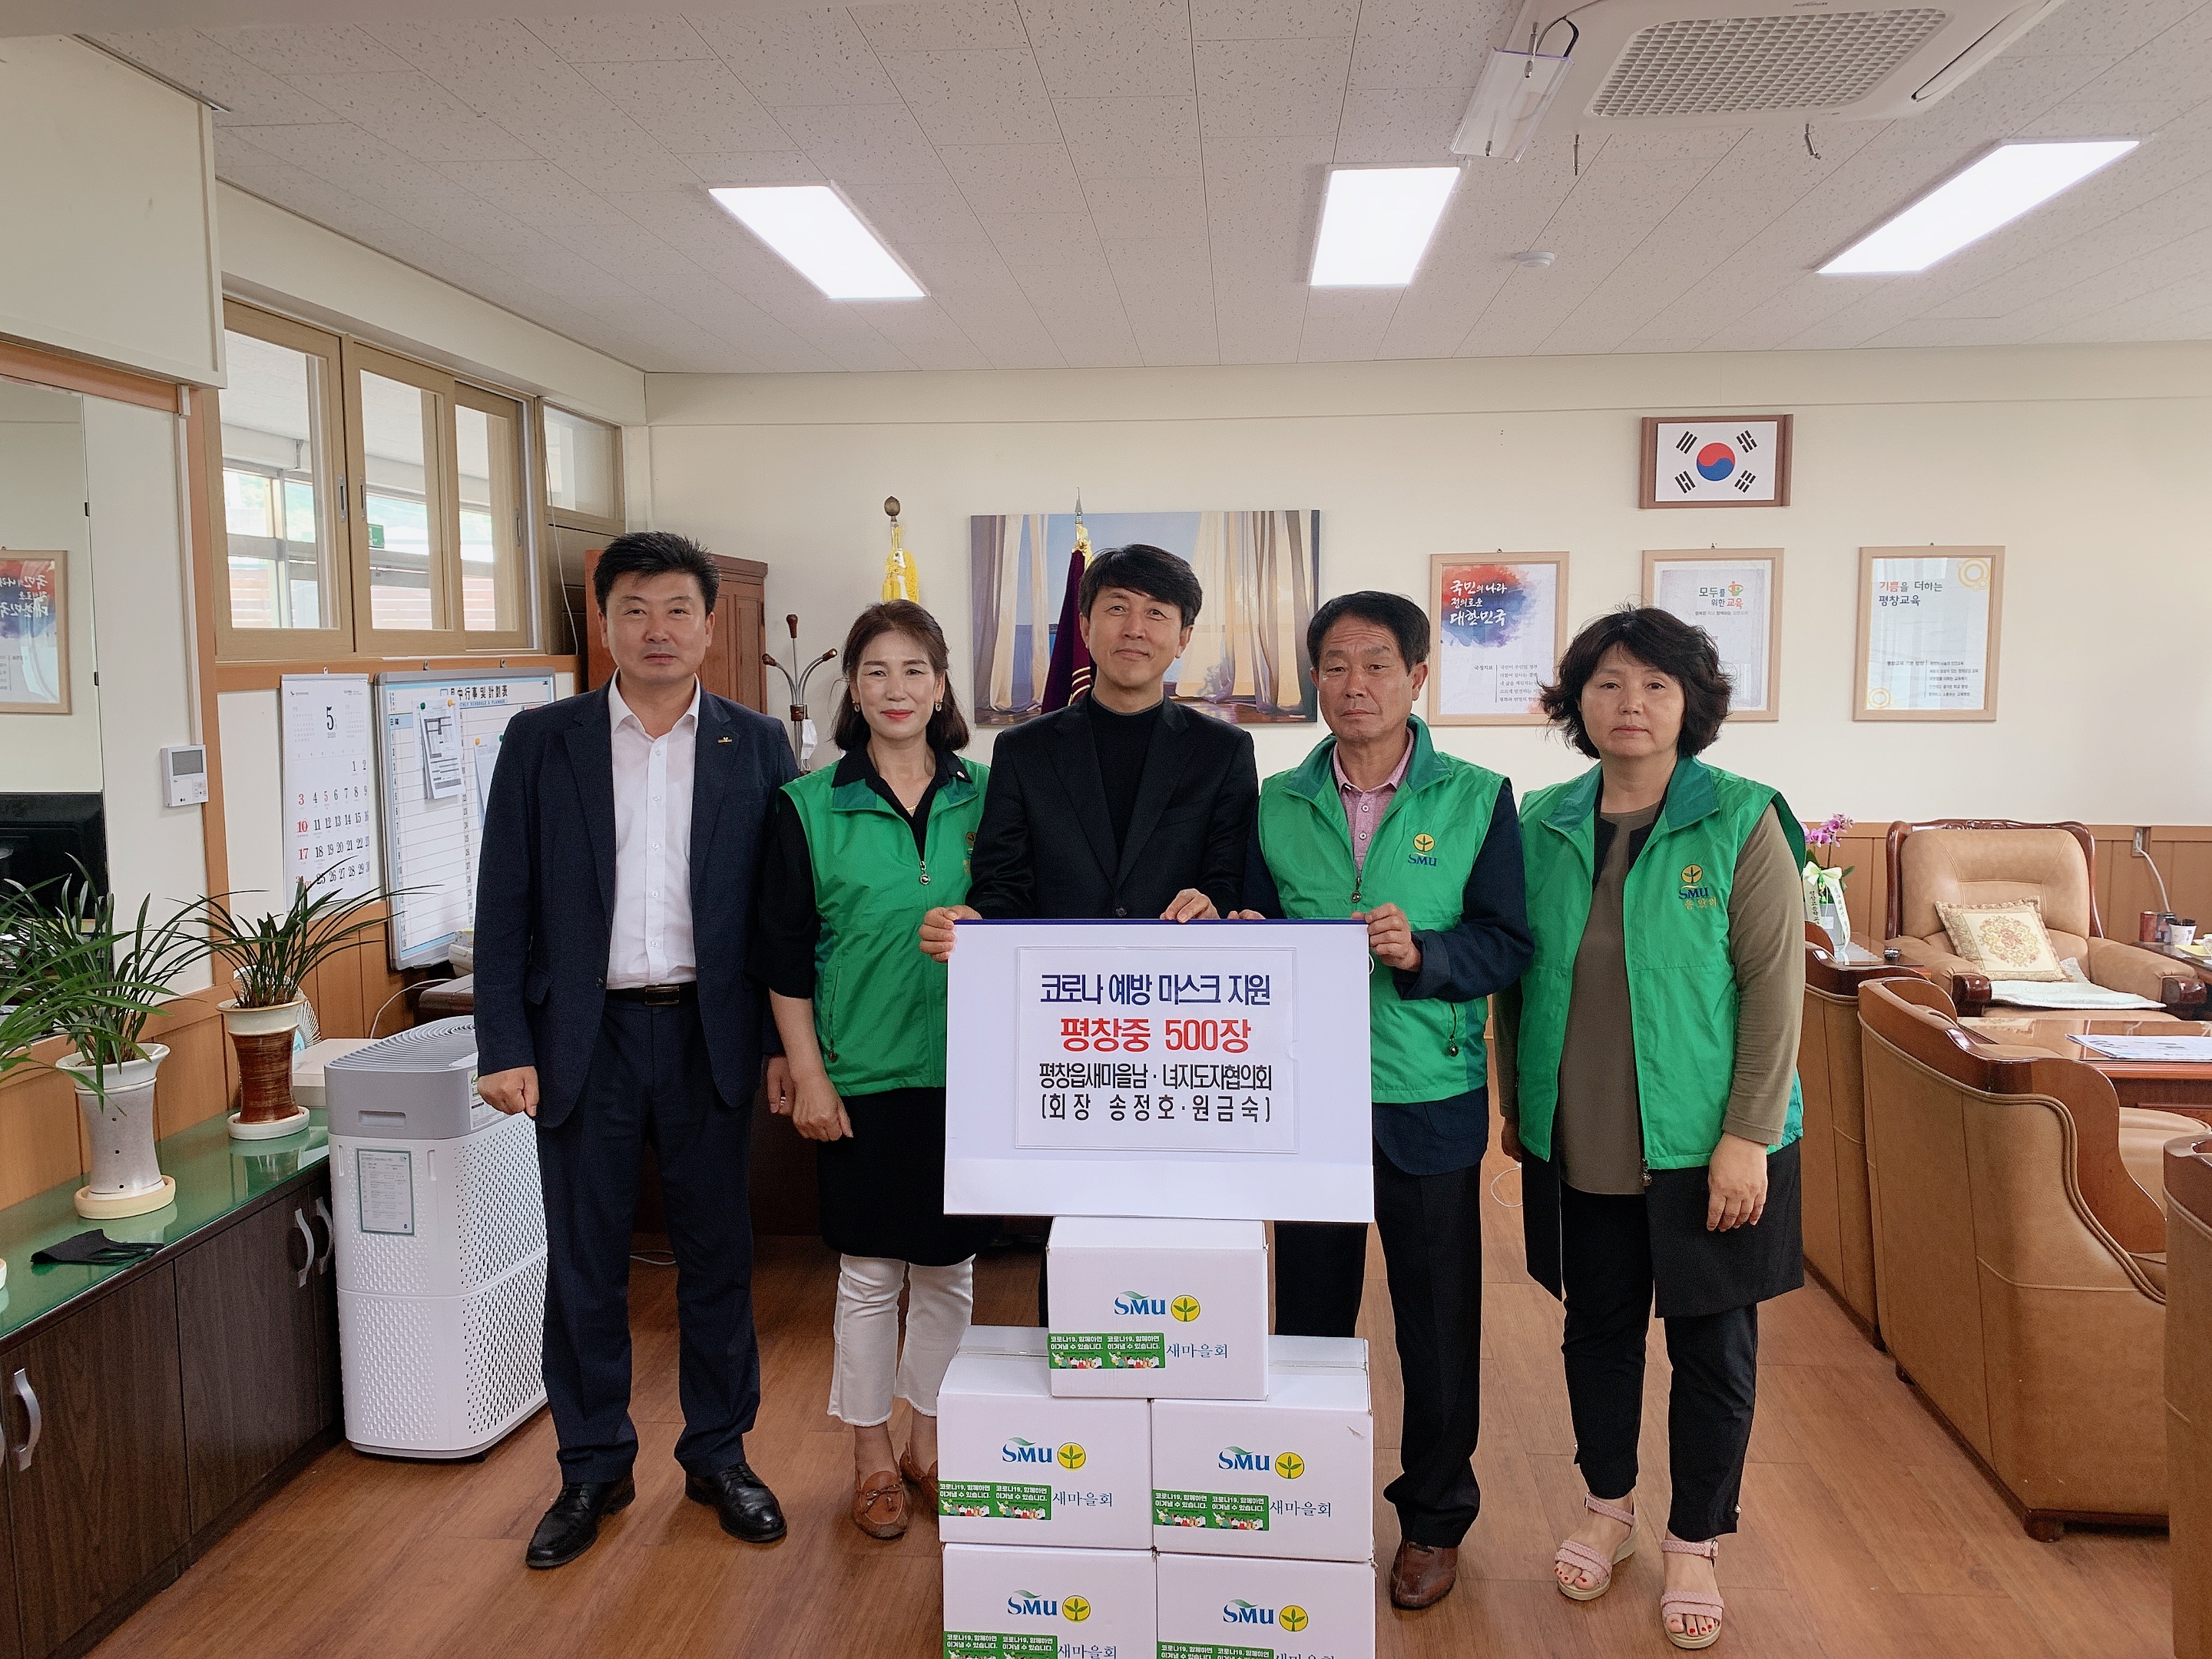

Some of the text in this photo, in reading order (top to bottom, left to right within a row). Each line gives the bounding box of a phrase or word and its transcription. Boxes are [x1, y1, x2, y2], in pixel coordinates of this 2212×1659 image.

[1450, 579, 1508, 594] 국민의 나라
[1699, 587, 1725, 598] 모두를
[1879, 581, 1943, 592] 기쁨을 더하는
[1450, 598, 1483, 609] 정의로운
[1727, 598, 1743, 609] 교육
[1879, 594, 1920, 607] 평창교육
[1449, 609, 1507, 626] 대한민국
[326, 707, 333, 730] 5
[353, 760, 366, 771] 1 2
[299, 793, 304, 805] 3
[313, 792, 317, 803] 4
[324, 790, 328, 802] 5
[333, 789, 338, 800] 6
[344, 787, 348, 799] 7
[354, 786, 359, 797] 8
[297, 821, 308, 833] 10
[313, 819, 321, 830] 11
[325, 817, 331, 829] 12
[335, 816, 341, 827] 13
[344, 813, 351, 825] 14
[355, 812, 361, 823] 15
[299, 848, 309, 860] 17
[315, 846, 323, 858] 18
[327, 843, 333, 856] 19
[336, 842, 343, 853] 20
[346, 839, 353, 851] 21
[356, 837, 363, 849] 22
[1408, 853, 1437, 866] SMU
[329, 869, 336, 882] 26
[339, 868, 345, 879] 27
[348, 865, 355, 877] 28
[358, 863, 364, 875] 29
[1678, 887, 1709, 899] SMU
[1040, 974, 1270, 1006] 코로나 예방 마스크 지원
[1061, 1017, 1252, 1053] 평창중 500장
[1114, 1295, 1166, 1316] SMU
[1166, 1343, 1227, 1359] 새마을회
[1002, 1443, 1052, 1463] SMU
[1219, 1451, 1270, 1471] SMU
[1052, 1492, 1112, 1507] 새마을회
[1270, 1500, 1331, 1517] 새마을회
[1008, 1597, 1057, 1616] SMU
[1223, 1604, 1273, 1624] SMU
[1058, 1644, 1117, 1659] 새마을회
